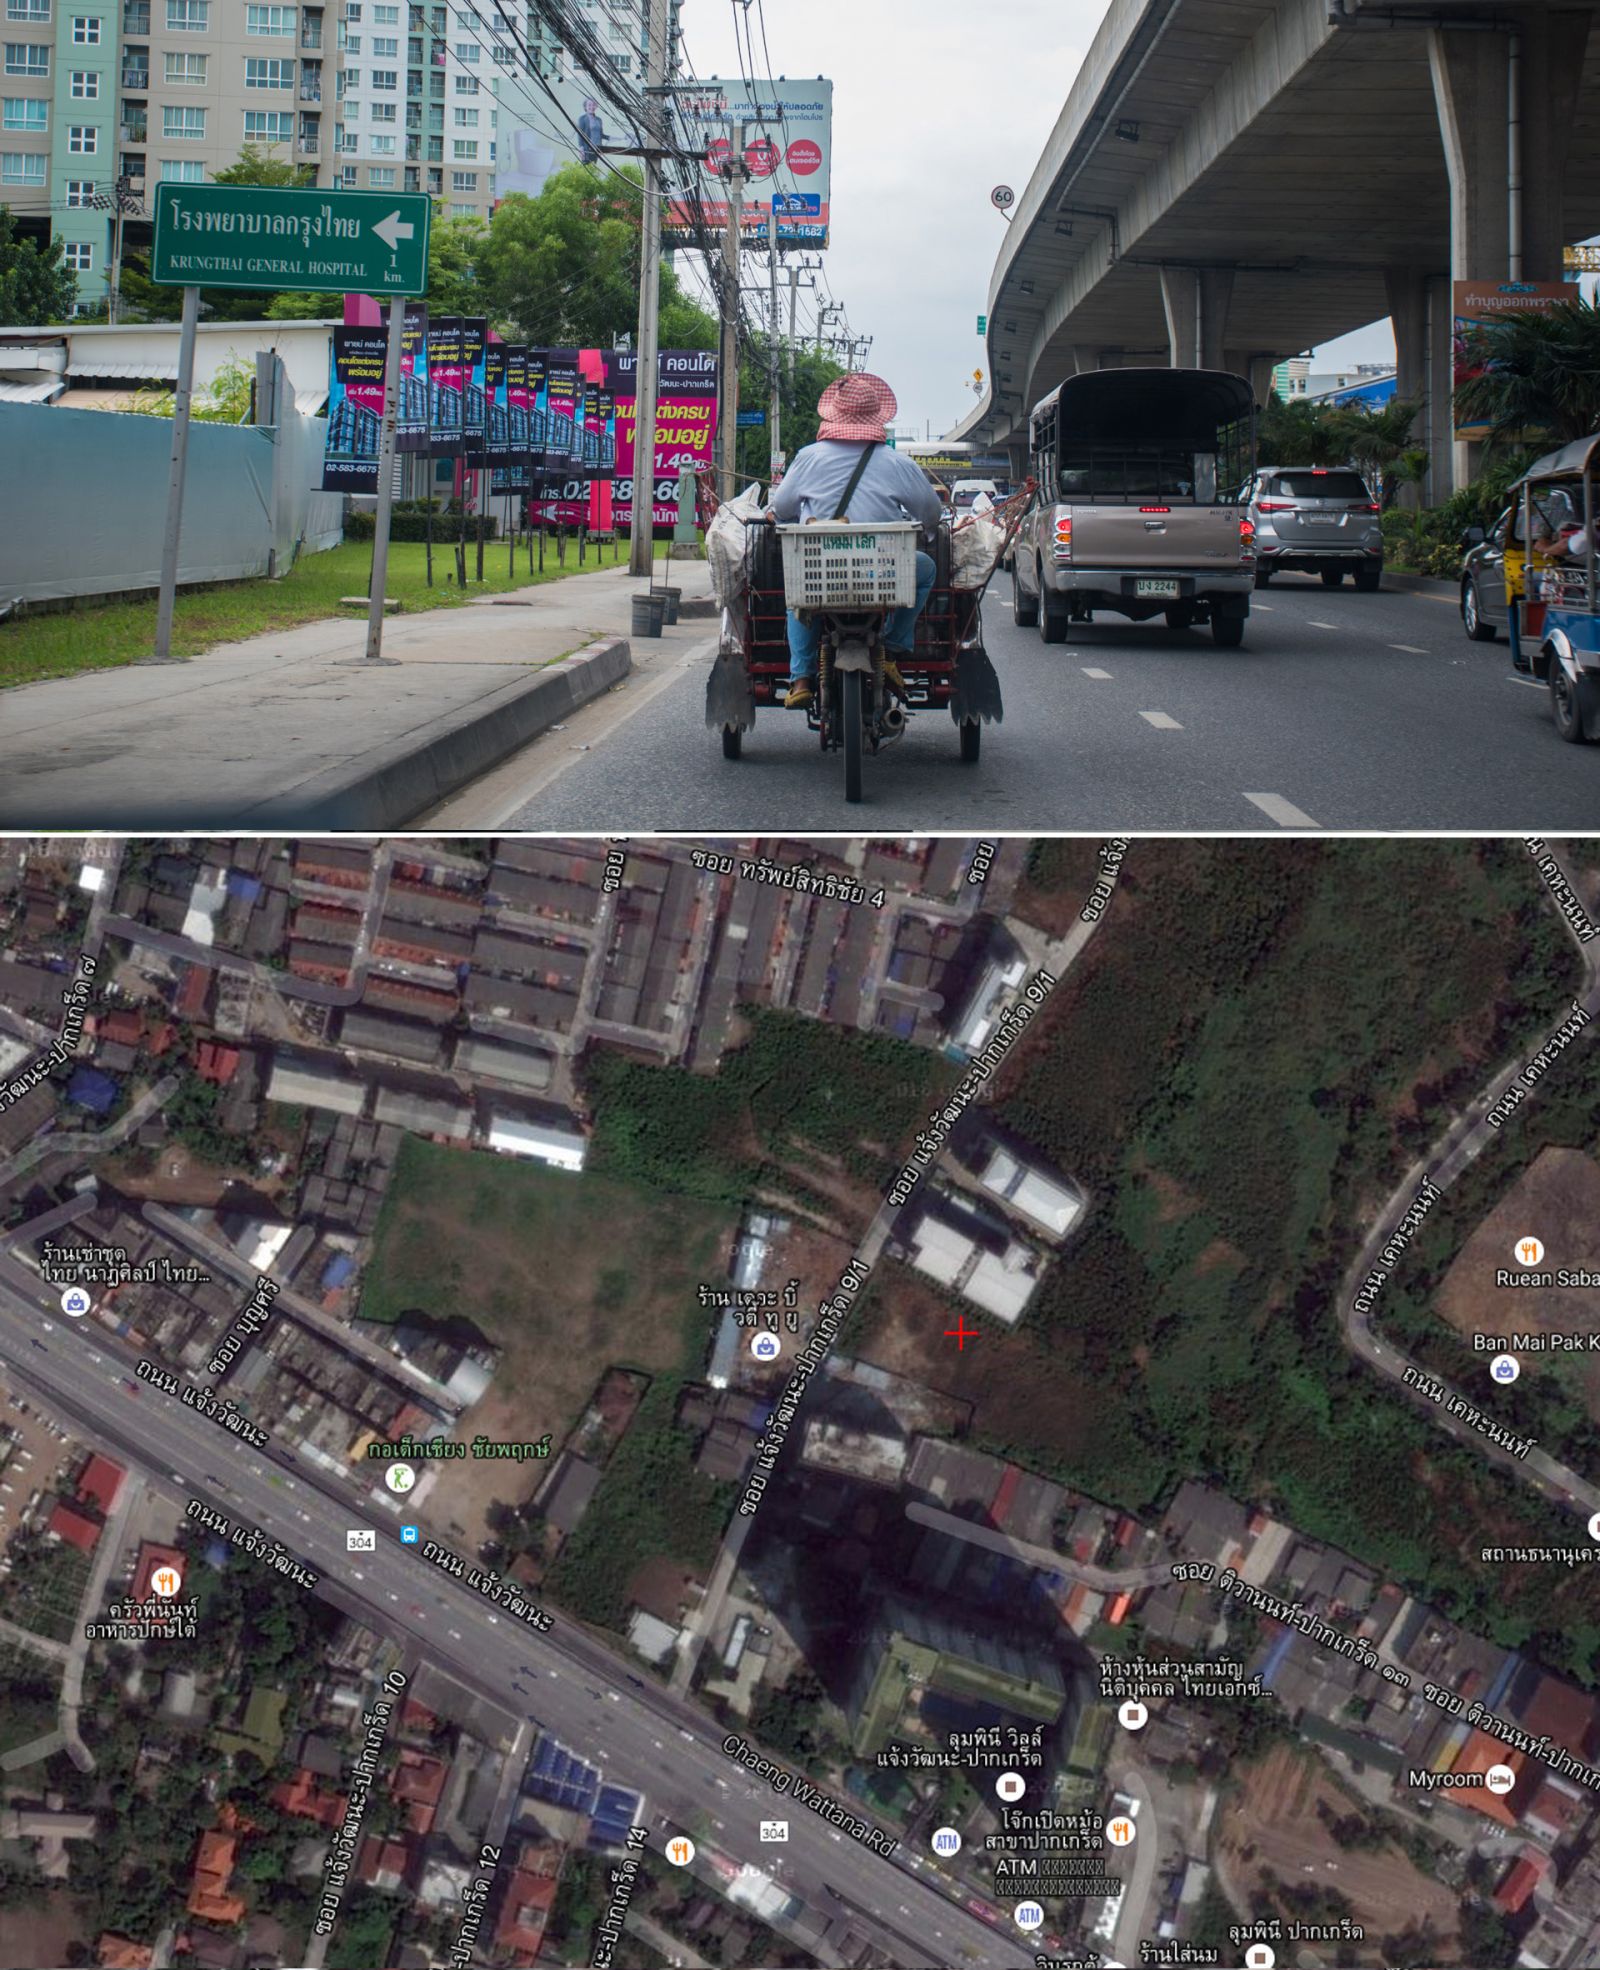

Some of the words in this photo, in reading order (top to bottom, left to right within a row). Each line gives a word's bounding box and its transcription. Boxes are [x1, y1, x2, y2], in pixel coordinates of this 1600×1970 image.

[995, 191, 1012, 202] 60
[170, 199, 361, 248] โรงพยาบาลกรุงไทย
[170, 255, 243, 271] KRUNGTHAI
[246, 258, 303, 274] GENERAL
[308, 261, 368, 277] HOSPITAL
[389, 254, 398, 267] 1
[383, 270, 405, 283] km.
[666, 352, 715, 372] คอนโด
[326, 463, 377, 473] 02-583-6675
[1155, 581, 1177, 591] 2244
